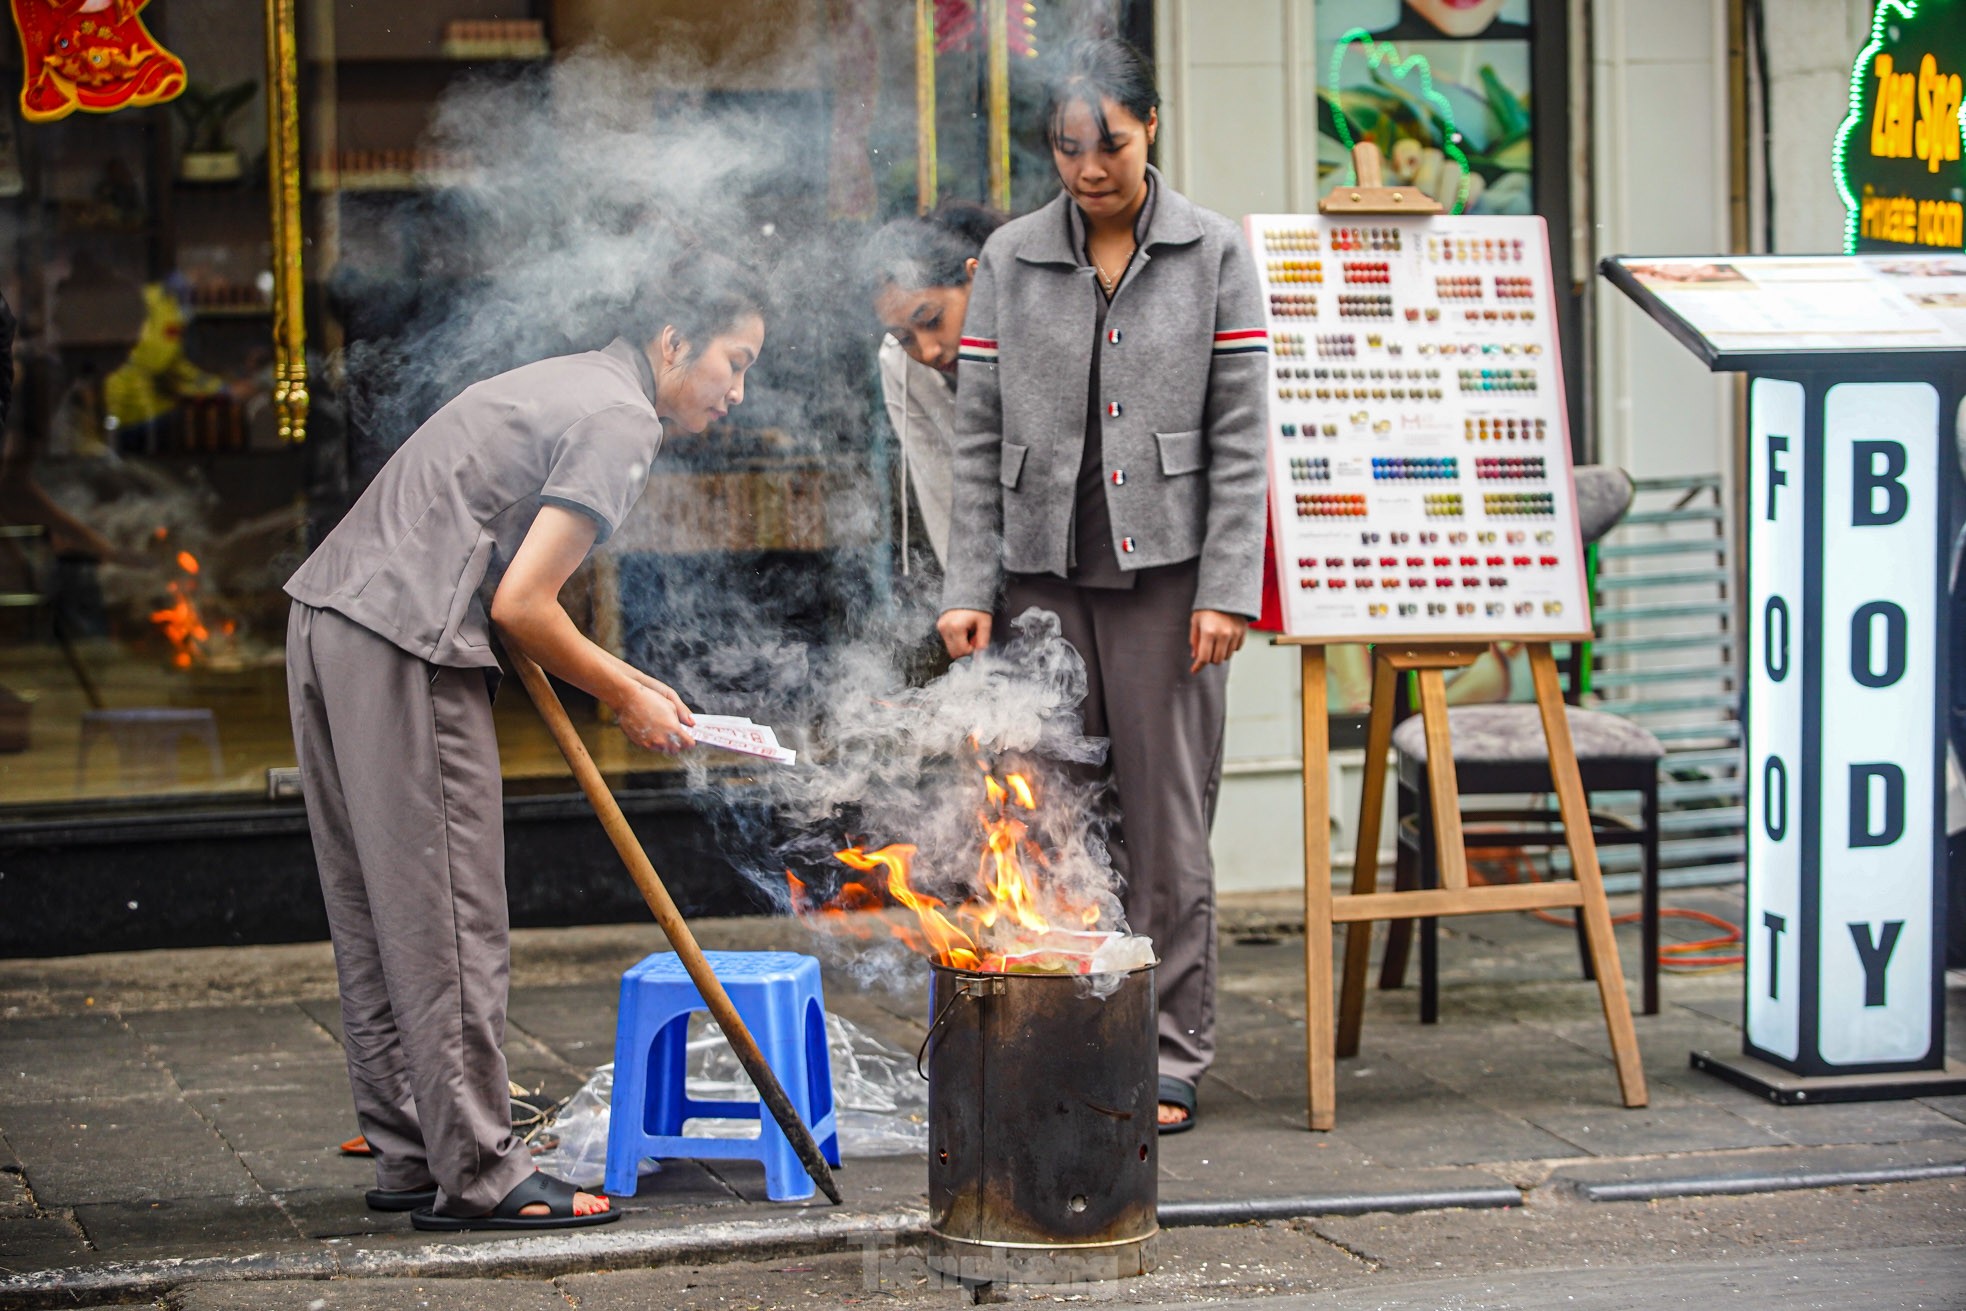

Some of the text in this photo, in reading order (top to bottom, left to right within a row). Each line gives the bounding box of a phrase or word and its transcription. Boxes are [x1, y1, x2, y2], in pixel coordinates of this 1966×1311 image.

[1870, 52, 1963, 174] Zen Spa
[1764, 435, 1789, 1000] FOOT
[1847, 440, 1909, 1007] BODY
